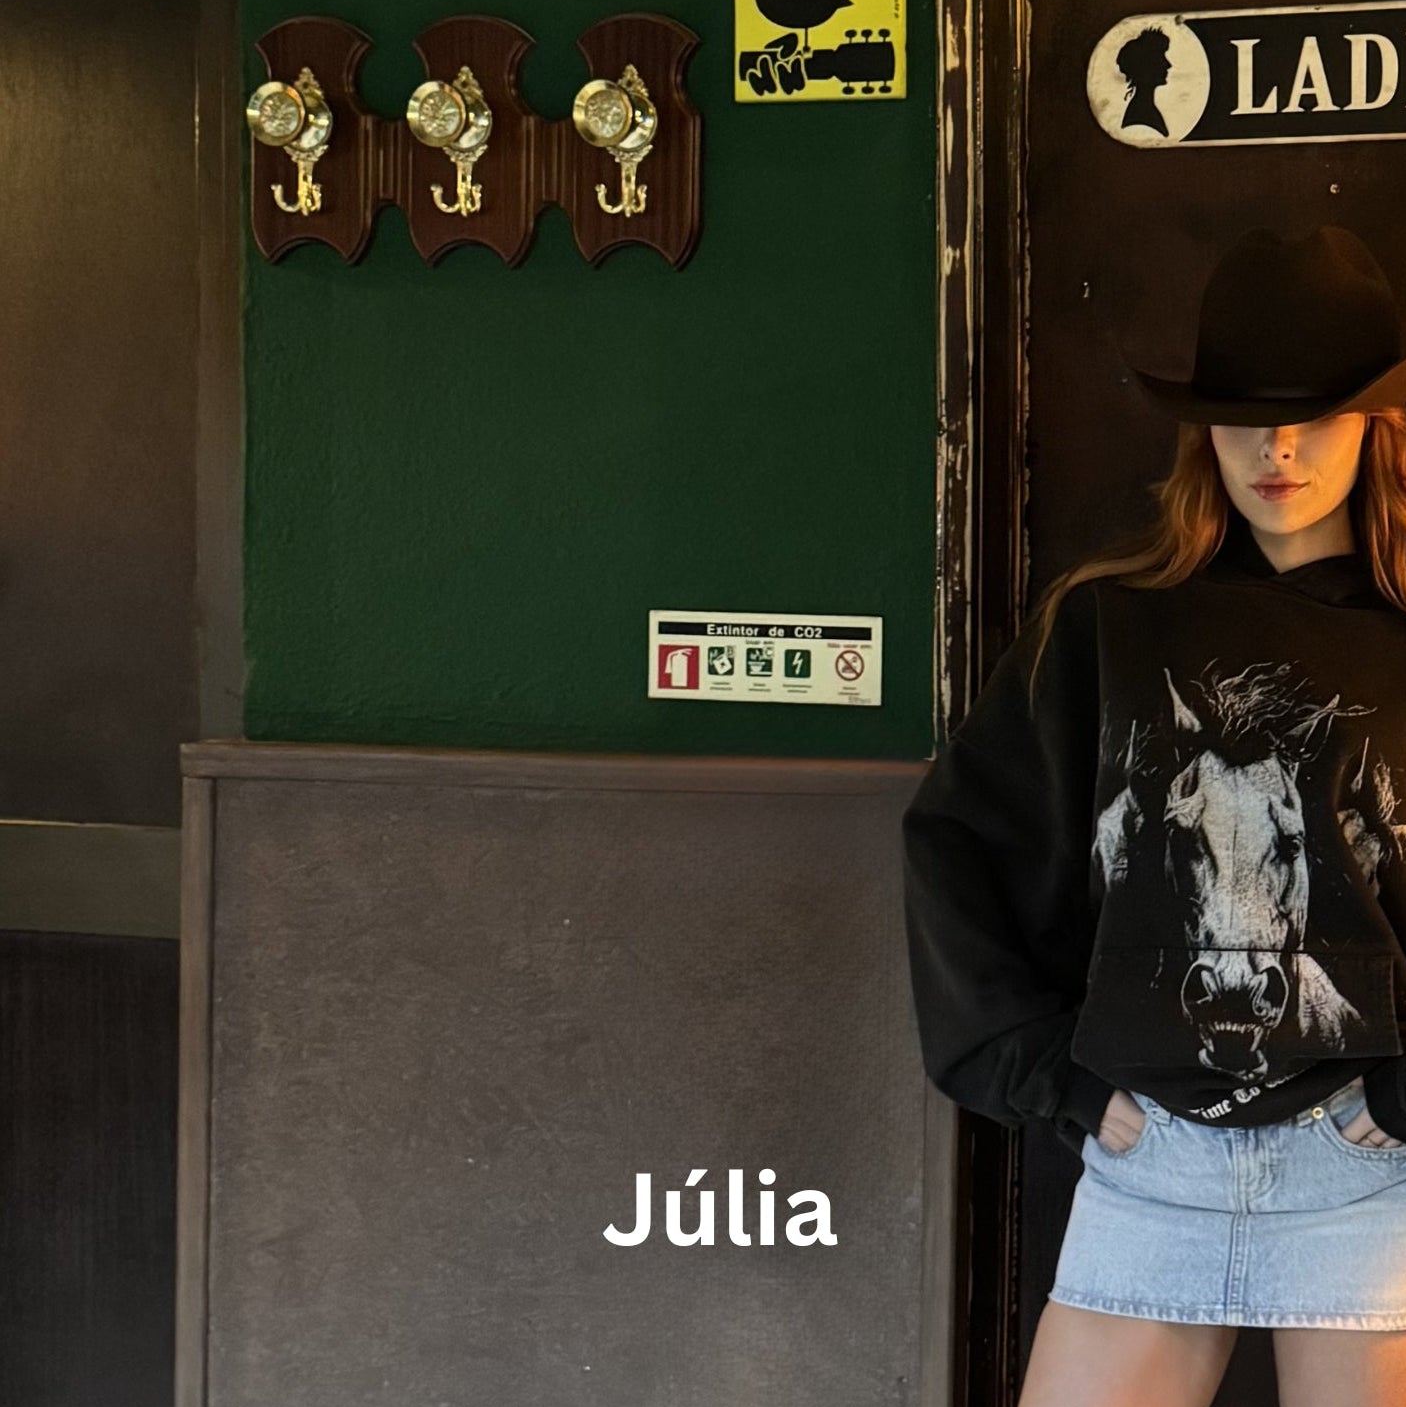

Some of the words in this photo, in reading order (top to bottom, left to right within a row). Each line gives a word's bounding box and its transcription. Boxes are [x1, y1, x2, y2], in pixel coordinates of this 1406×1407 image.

[706, 624, 759, 637] Extintor
[768, 626, 785, 638] de
[794, 627, 822, 639] CO2
[1187, 1099, 1232, 1119] ime
[1233, 1086, 1261, 1103] To
